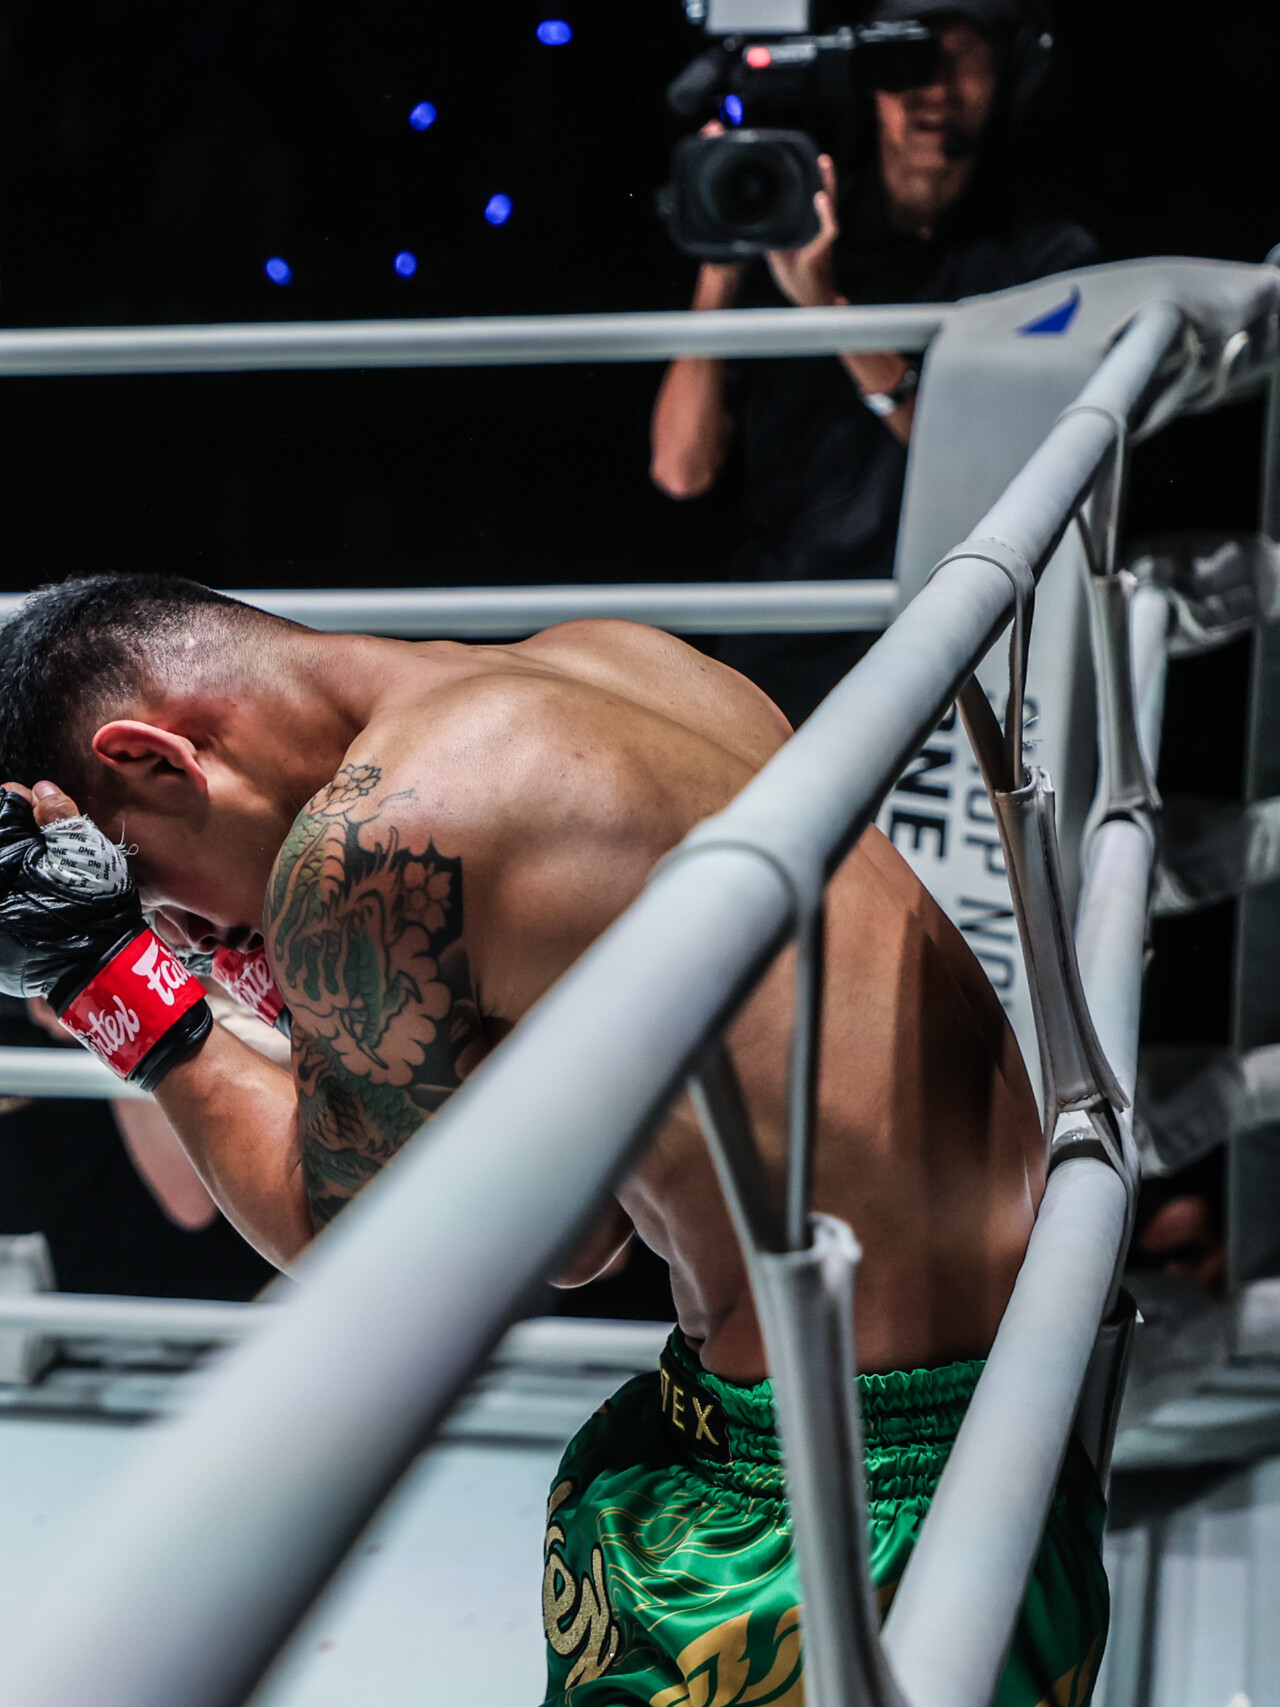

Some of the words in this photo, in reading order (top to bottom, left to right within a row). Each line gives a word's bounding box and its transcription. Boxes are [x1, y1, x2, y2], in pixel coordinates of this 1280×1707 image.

[78, 846, 96, 857] ONE
[60, 858, 78, 868] ONE
[660, 1368, 719, 1446] TEX
